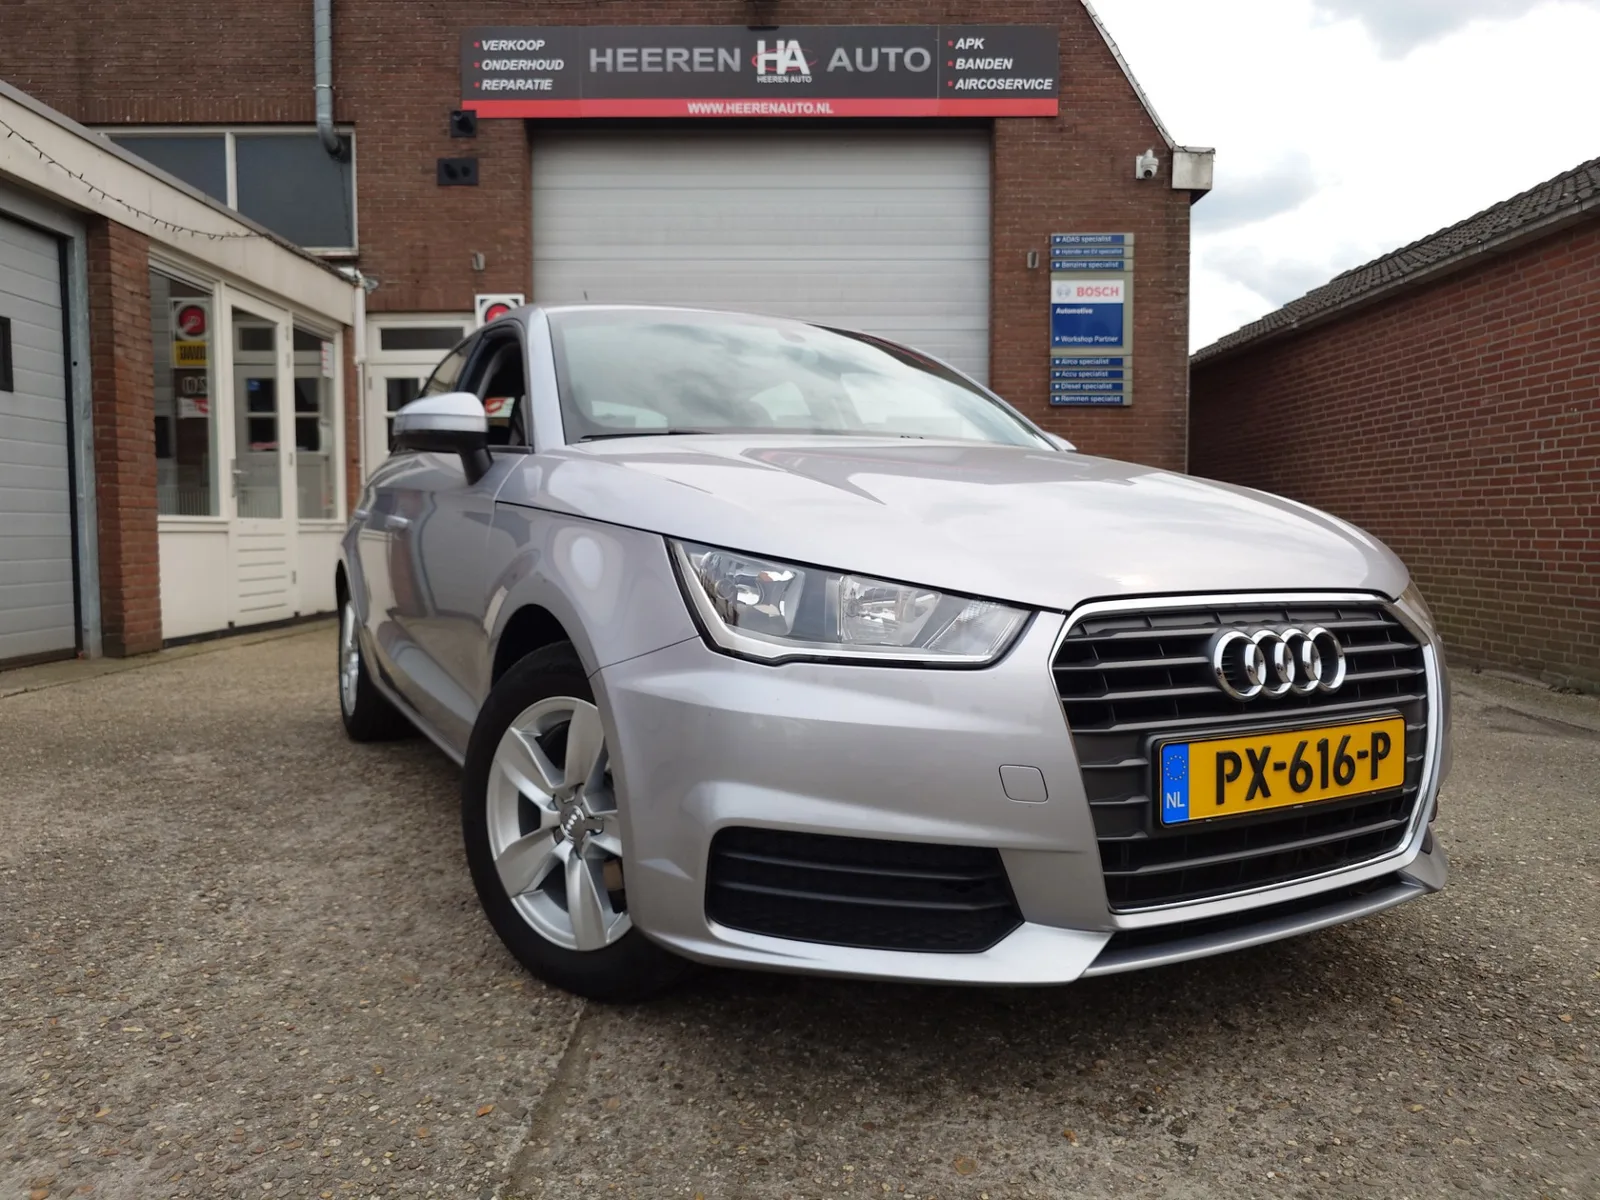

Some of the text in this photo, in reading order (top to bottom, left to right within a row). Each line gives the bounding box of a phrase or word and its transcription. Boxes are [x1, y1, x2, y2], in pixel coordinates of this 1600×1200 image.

[481, 40, 546, 51] VERKOOP
[955, 38, 985, 50] APK
[590, 40, 931, 75] HEEREN HA AUTO
[481, 60, 564, 71] ONDERHOUD
[955, 58, 1013, 70] BANDEN
[481, 79, 553, 91] REPARATIE
[955, 79, 1053, 90] AIRCOSERVICE
[687, 102, 834, 114] WWW.HEERENAUTO.NL
[1081, 235, 1112, 243] specialist
[1088, 261, 1119, 269] specialist
[1077, 287, 1119, 297] BOSCH
[1061, 335, 1093, 343] Workshop
[1079, 358, 1109, 366] specialist
[1079, 371, 1108, 379] specialist
[1082, 383, 1112, 391] specialist
[1215, 732, 1391, 806] PX-616-P
[1165, 791, 1185, 809] NL
